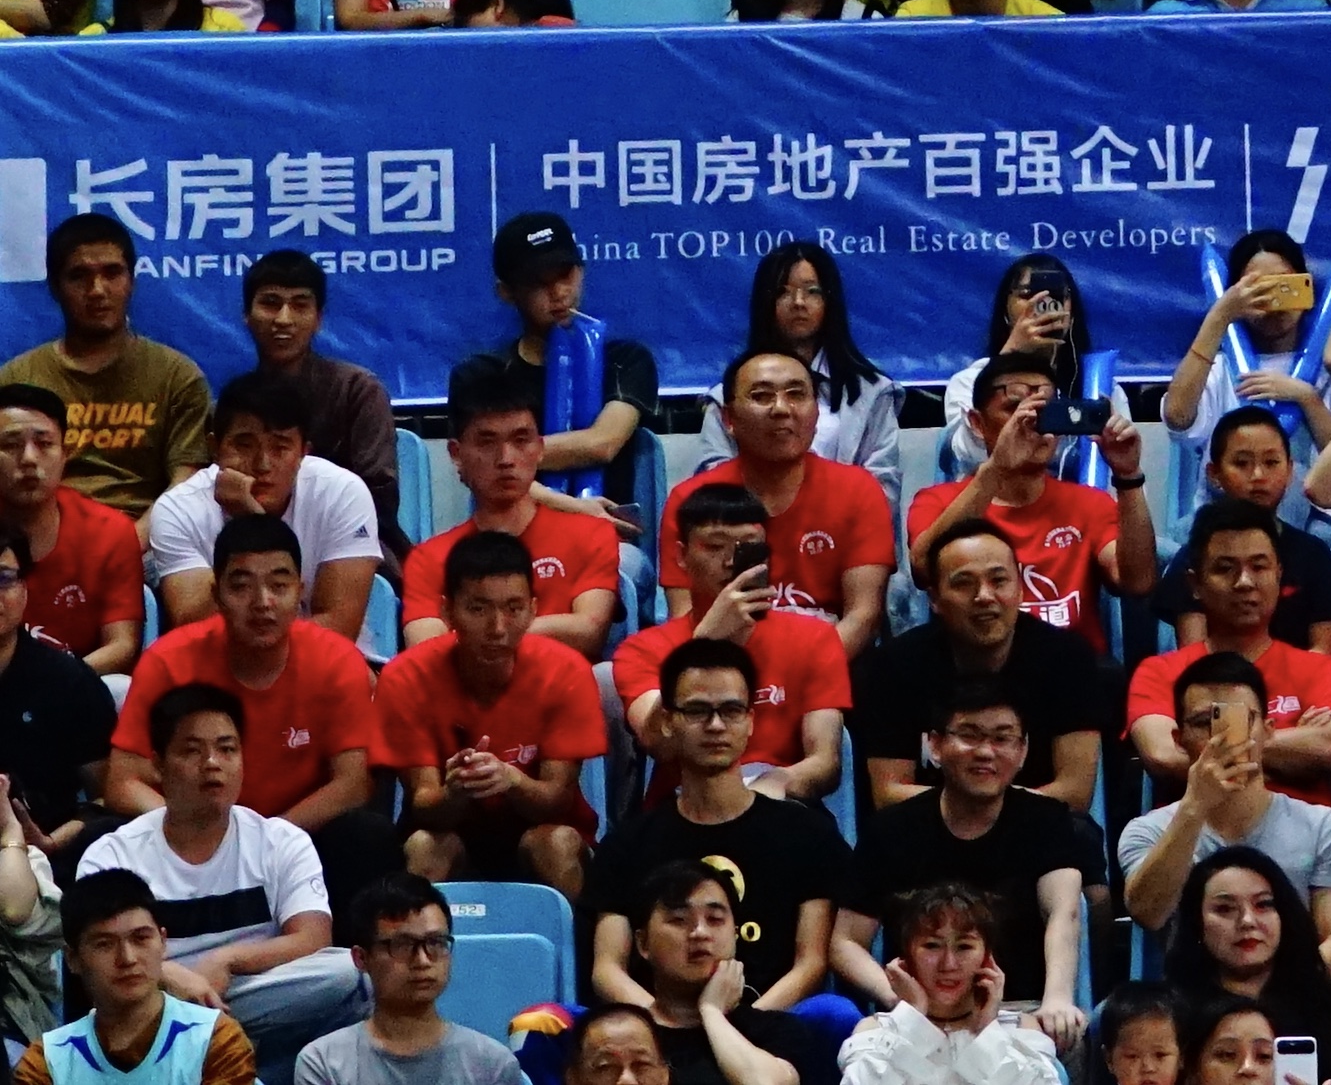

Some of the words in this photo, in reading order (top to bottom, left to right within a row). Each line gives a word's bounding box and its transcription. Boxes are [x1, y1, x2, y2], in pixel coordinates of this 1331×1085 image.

[542, 123, 1216, 209] 中国房地产百强企业
[69, 148, 456, 241] 长房集团
[571, 232, 641, 261] hina
[815, 224, 887, 255] Real
[907, 224, 1011, 253] Estate
[1030, 218, 1217, 255] Developers
[134, 253, 262, 278] ANFIN
[308, 247, 456, 274] GROUP
[66, 401, 157, 426] RITUAL
[63, 427, 146, 449] PPORT
